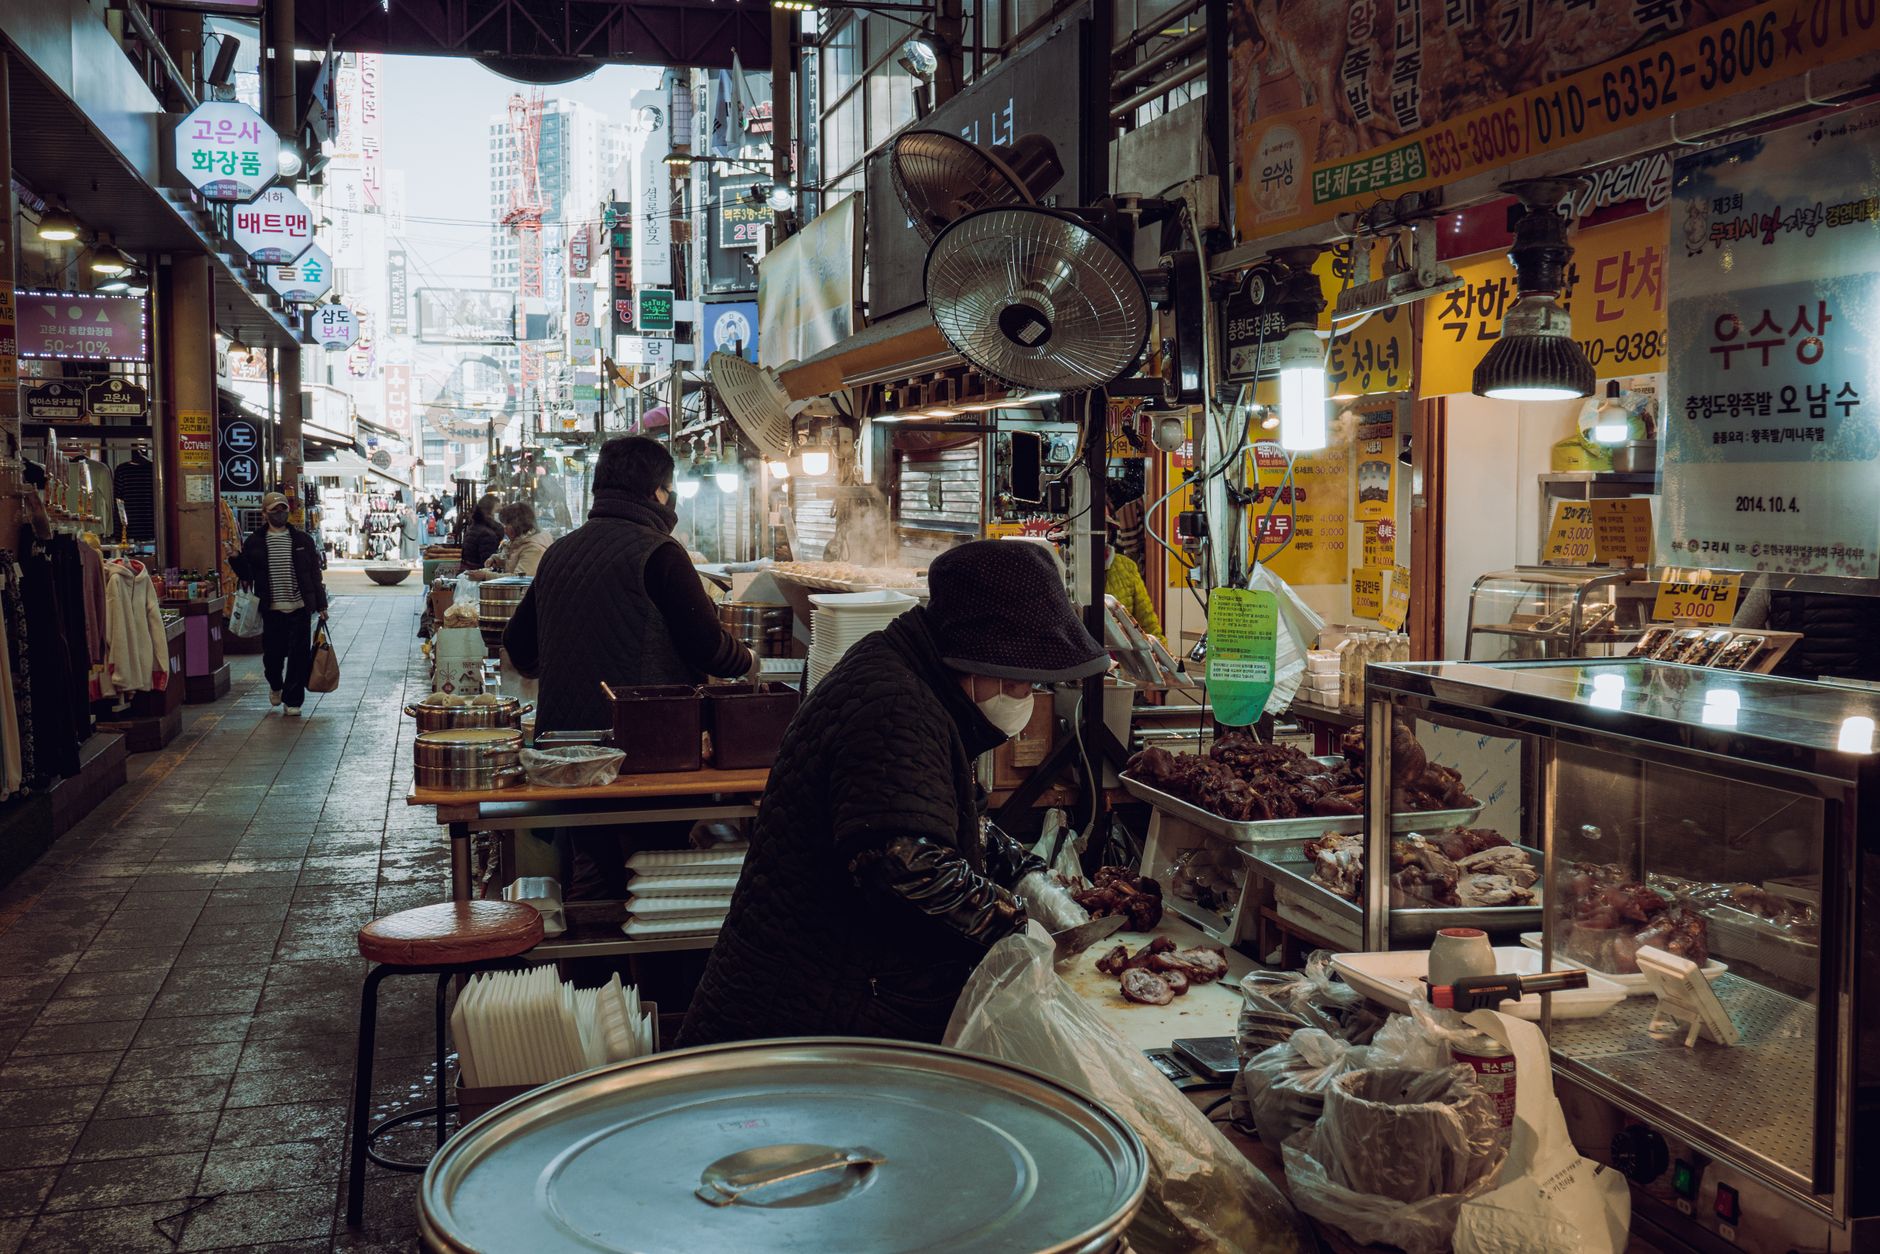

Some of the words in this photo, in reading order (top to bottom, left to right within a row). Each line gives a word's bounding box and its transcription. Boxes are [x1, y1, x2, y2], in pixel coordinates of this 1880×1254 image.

[191, 120, 261, 145] 고은사
[191, 148, 261, 177] 화장품
[1314, 142, 1424, 201] 단체주문환영
[1261, 158, 1294, 192] 우수상
[1712, 193, 1744, 215] 제3회
[237, 213, 307, 238] 배트맨
[1710, 213, 1758, 249] 구리시
[321, 309, 350, 325] 삼도
[40, 325, 66, 335] 고은사
[321, 325, 350, 341] 보석
[1709, 300, 1833, 371] 우수상
[44, 340, 111, 354] 50~10%
[103, 393, 131, 403] 고은사
[1685, 392, 1773, 420] 충청도왕족발
[1751, 426, 1825, 444] 왕족발/미니족발
[1735, 496, 1766, 513] 2014.
[1769, 496, 1786, 513] 10.
[1788, 496, 1801, 513] 4.
[1567, 527, 1593, 541] 3,000
[1562, 544, 1589, 557] 5,000
[1702, 541, 1731, 554] 구리시
